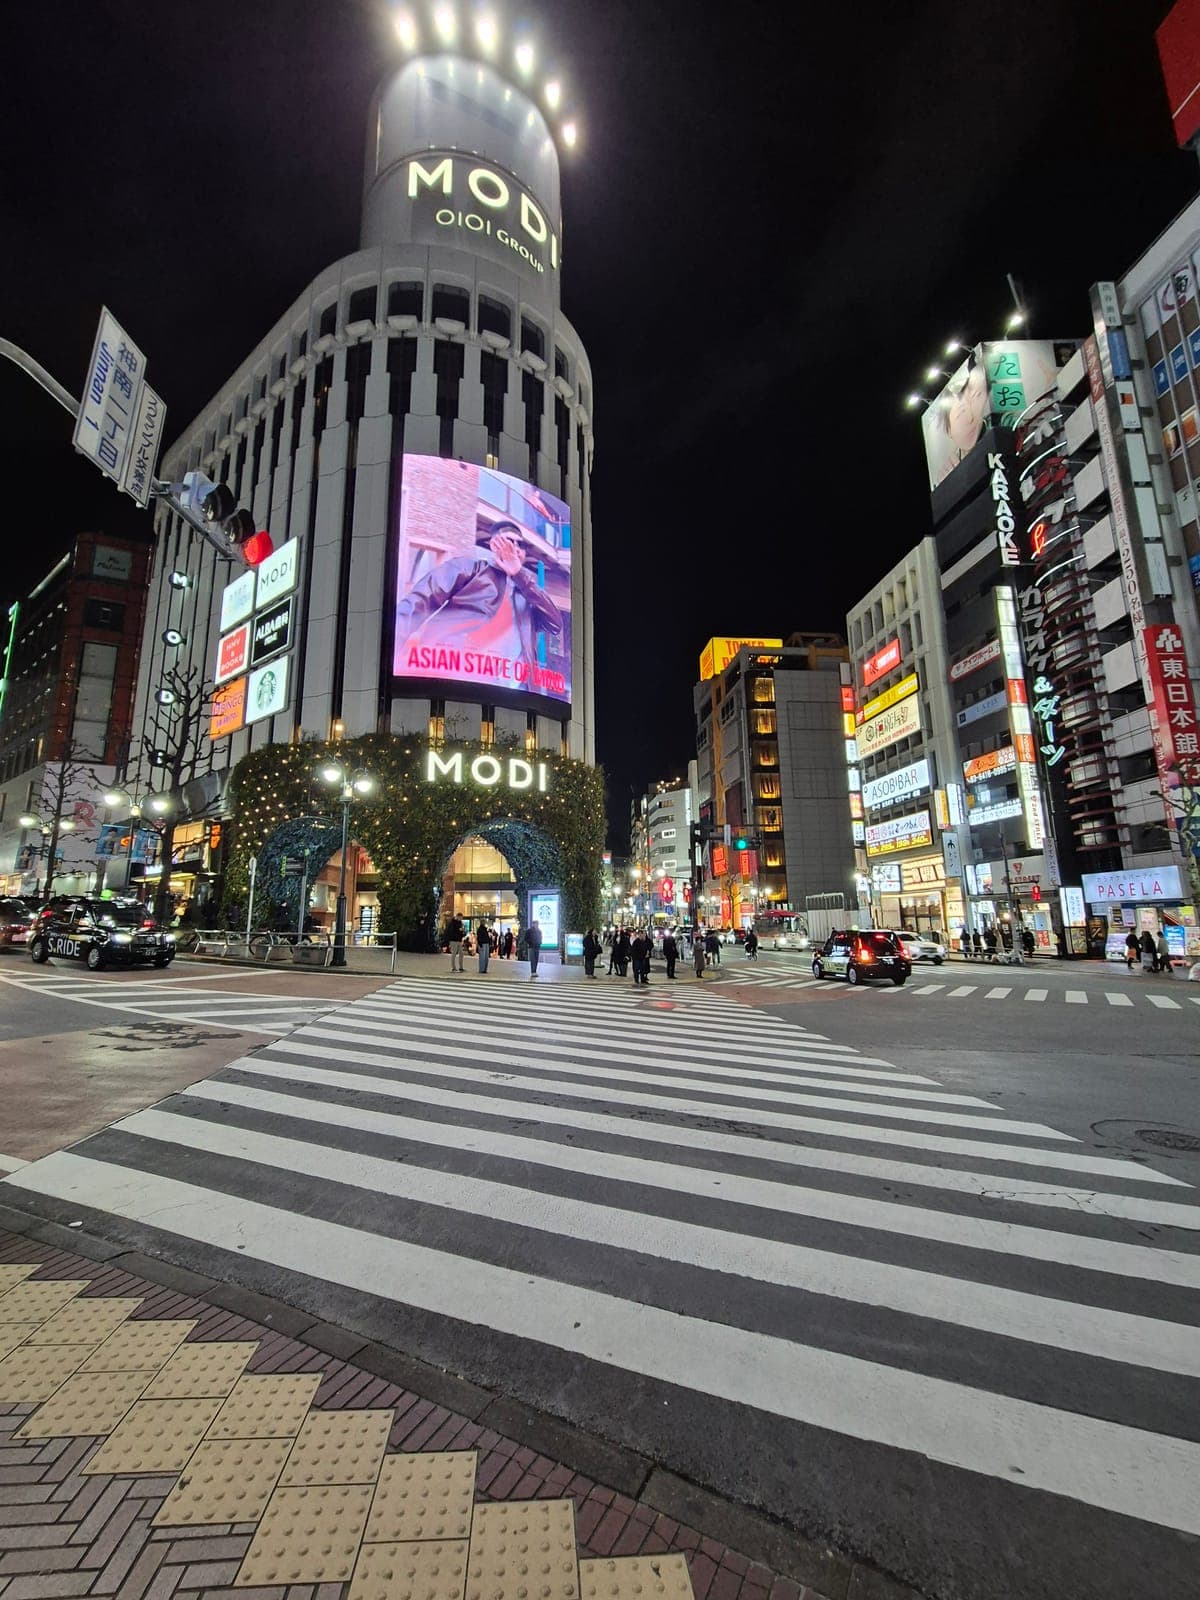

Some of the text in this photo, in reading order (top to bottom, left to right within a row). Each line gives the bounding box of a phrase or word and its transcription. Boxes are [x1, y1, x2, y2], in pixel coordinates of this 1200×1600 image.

[408, 159, 557, 269] MODI
[496, 229, 544, 273] GROUP
[85, 341, 115, 431] Jinnan 1
[99, 341, 138, 469] 神南一丁目
[987, 452, 1021, 566] KARAOKE
[259, 557, 293, 593] MODI
[407, 646, 461, 673] ASIAN
[464, 652, 511, 679] STATE
[514, 661, 531, 682] OF
[1160, 658, 1200, 781] 東日本銀行
[427, 750, 547, 792] MODI
[871, 769, 919, 801] ASOBIBAR
[1098, 880, 1163, 898] PASELA
[47, 937, 81, 957] S.RIDE
